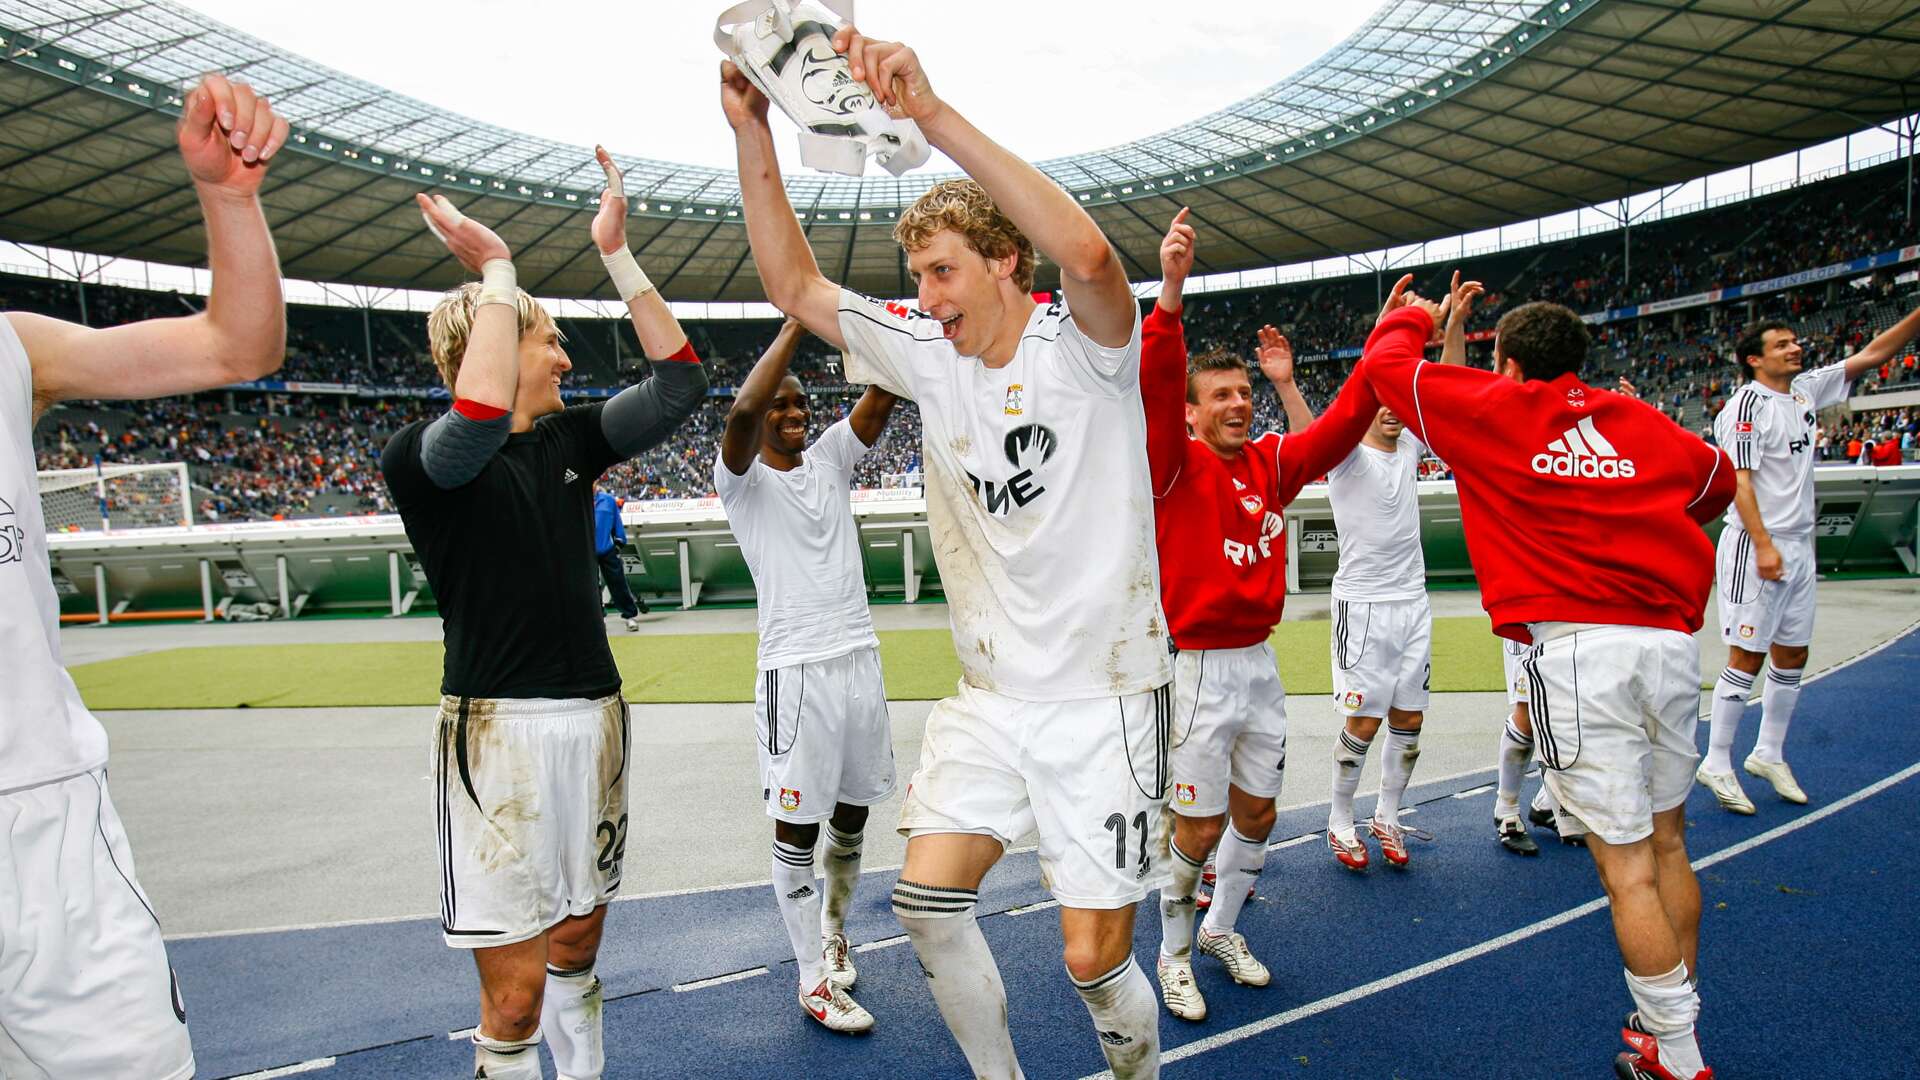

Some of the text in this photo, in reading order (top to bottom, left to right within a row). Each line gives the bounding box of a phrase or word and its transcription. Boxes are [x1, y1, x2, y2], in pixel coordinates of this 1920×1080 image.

[1531, 452, 1636, 478] adidas
[1316, 542, 1325, 551] 4
[596, 813, 628, 872] 22
[1104, 811, 1148, 869] 11
